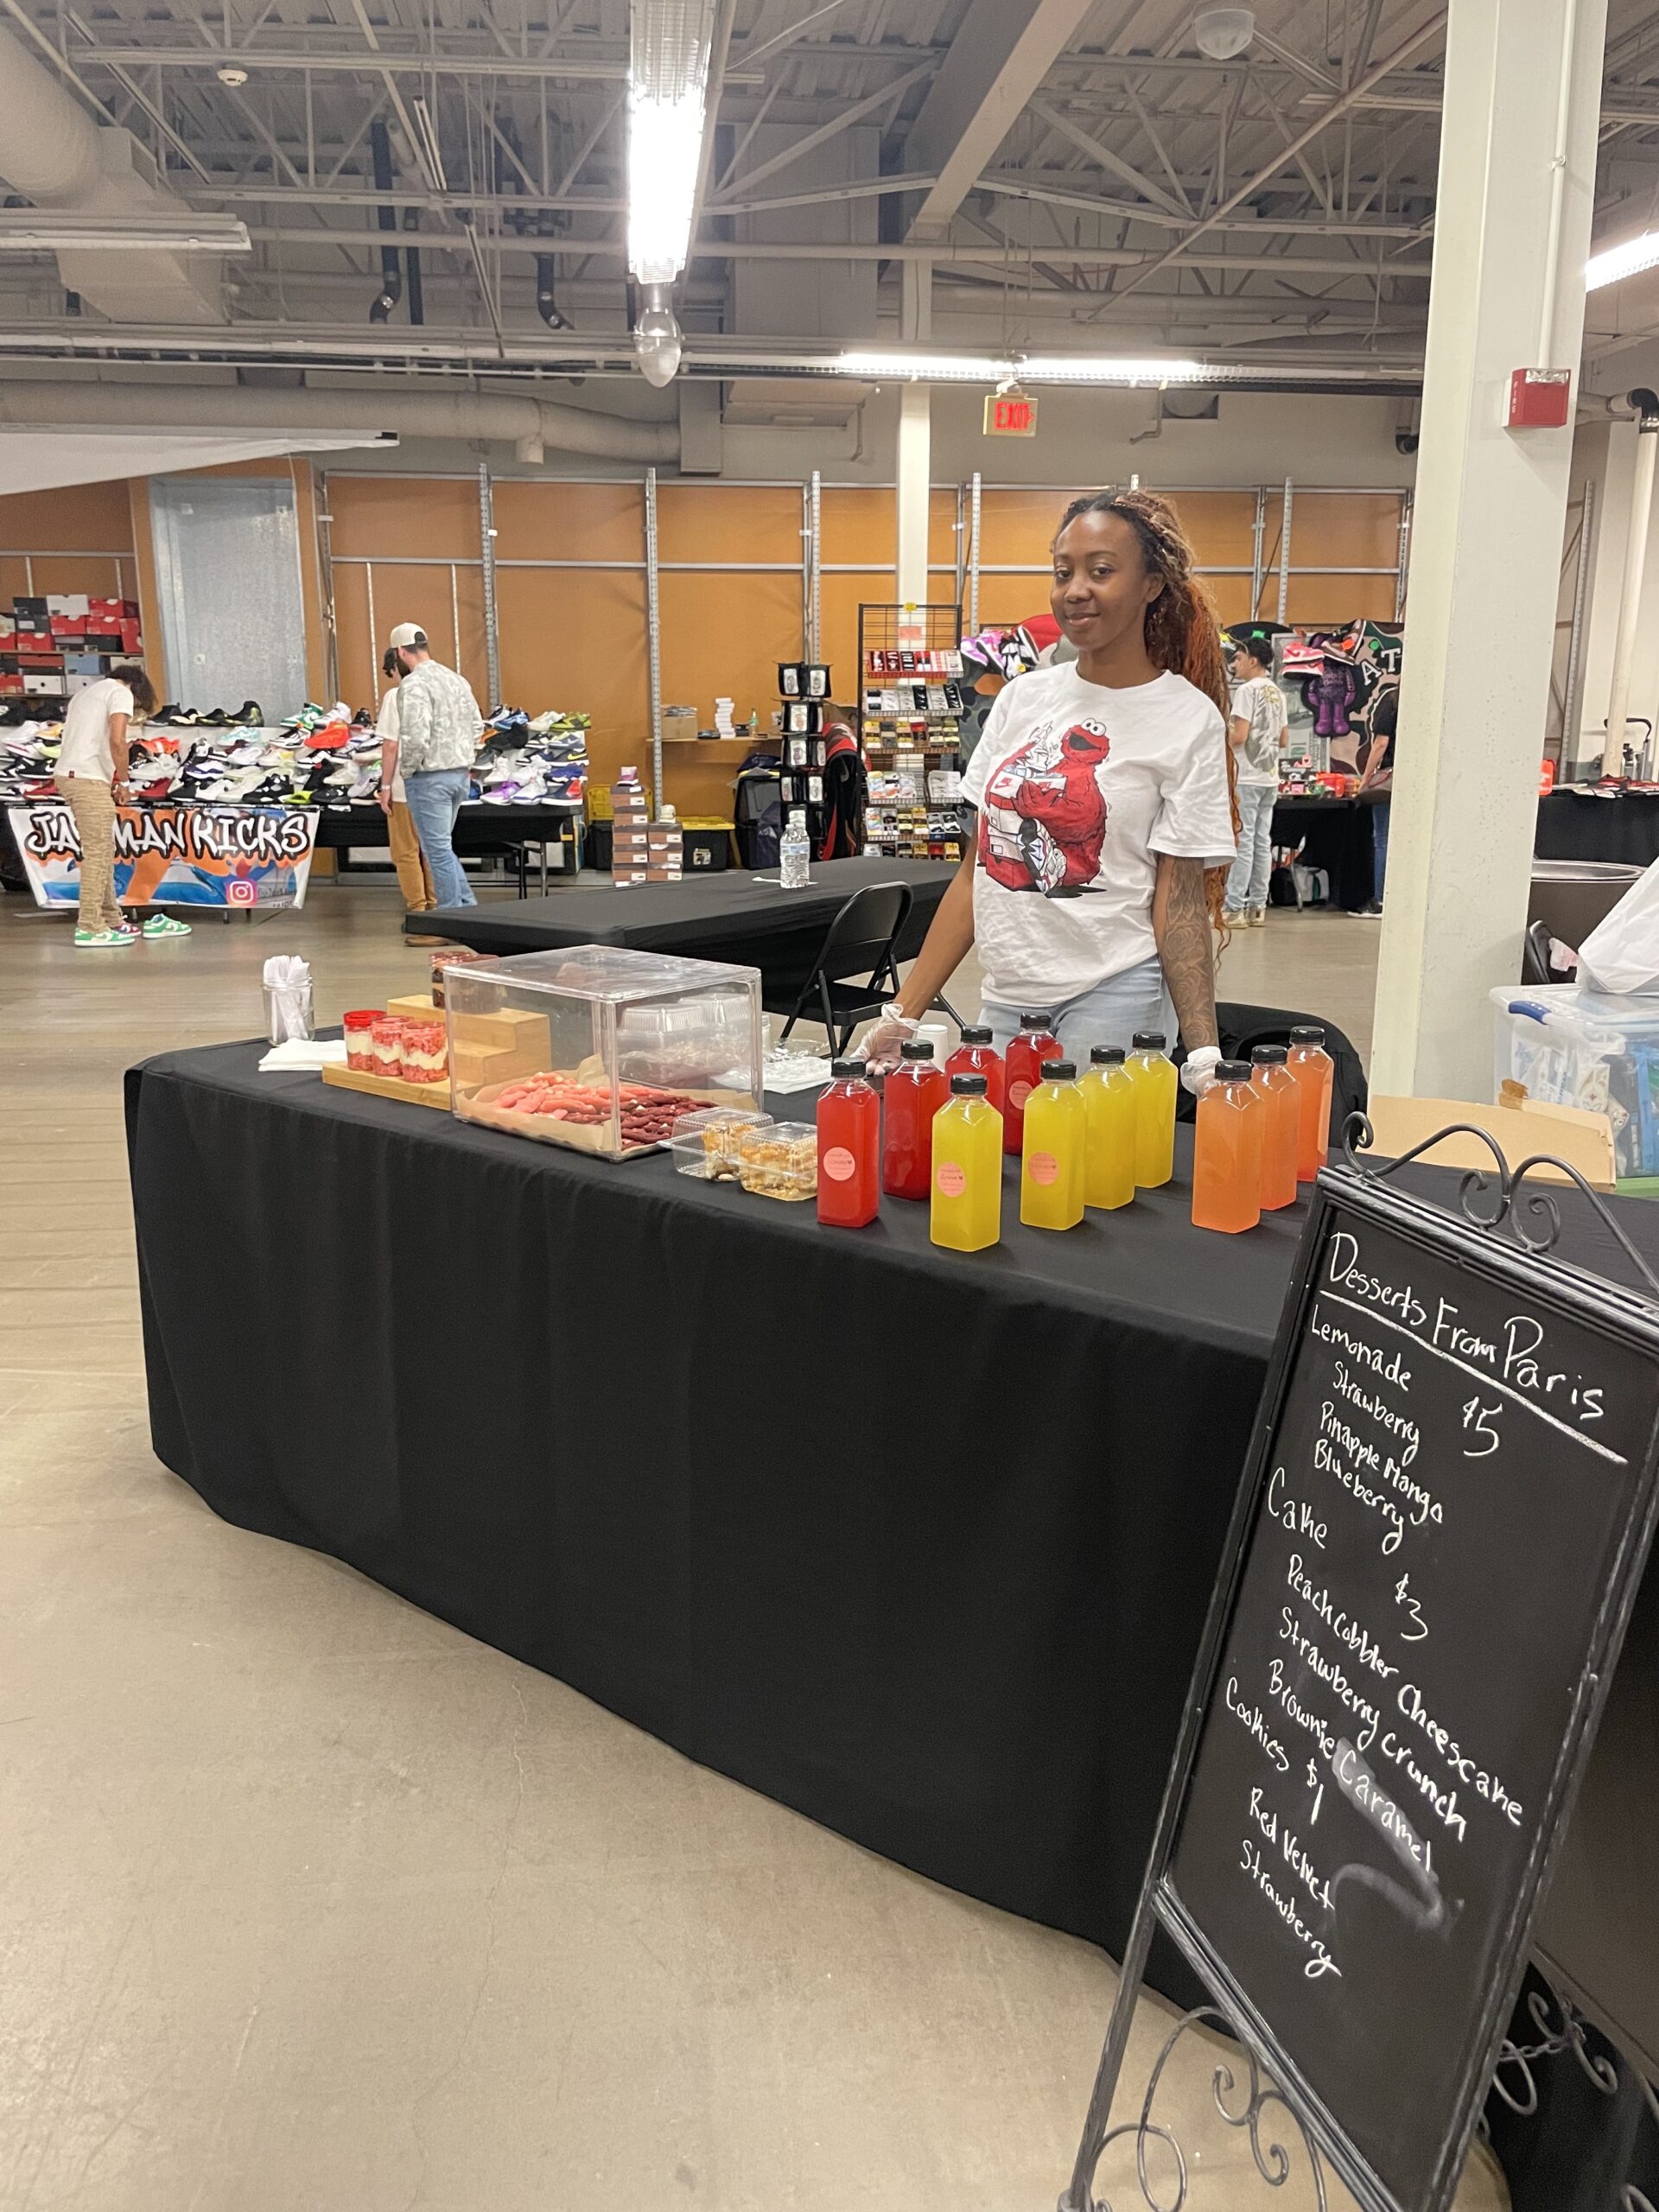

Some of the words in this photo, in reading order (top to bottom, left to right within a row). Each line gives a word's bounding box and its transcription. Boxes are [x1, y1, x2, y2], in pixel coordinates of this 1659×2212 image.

[995, 402, 1029, 429] EXIT
[24, 810, 188, 861] JAMAN
[190, 810, 309, 861] KICKS
[1312, 1305, 1412, 1391] Lemonade
[1330, 1232, 1427, 1325] Desserts
[1433, 1297, 1496, 1363] From
[1503, 1316, 1605, 1420] Paris
[1332, 1361, 1420, 1466] Strawberry
[1462, 1396, 1503, 1456] $5
[1268, 1467, 1328, 1549] Cake
[1314, 1439, 1404, 1554] Blueberry
[1385, 1458, 1442, 1525] Mango
[1288, 1554, 1332, 1626] Peach
[1395, 1573, 1428, 1641] $3
[1279, 1607, 1381, 1751] Strawberry
[1226, 1676, 1288, 1771] Cookies
[1306, 1758, 1323, 1825] $1
[1268, 1659, 1335, 1759] Brownie
[1339, 1750, 1431, 1872] Caramel
[1249, 1787, 1276, 1844] Red
[1283, 1829, 1335, 1910] Velvet
[1239, 1840, 1342, 1978] Strawberry
